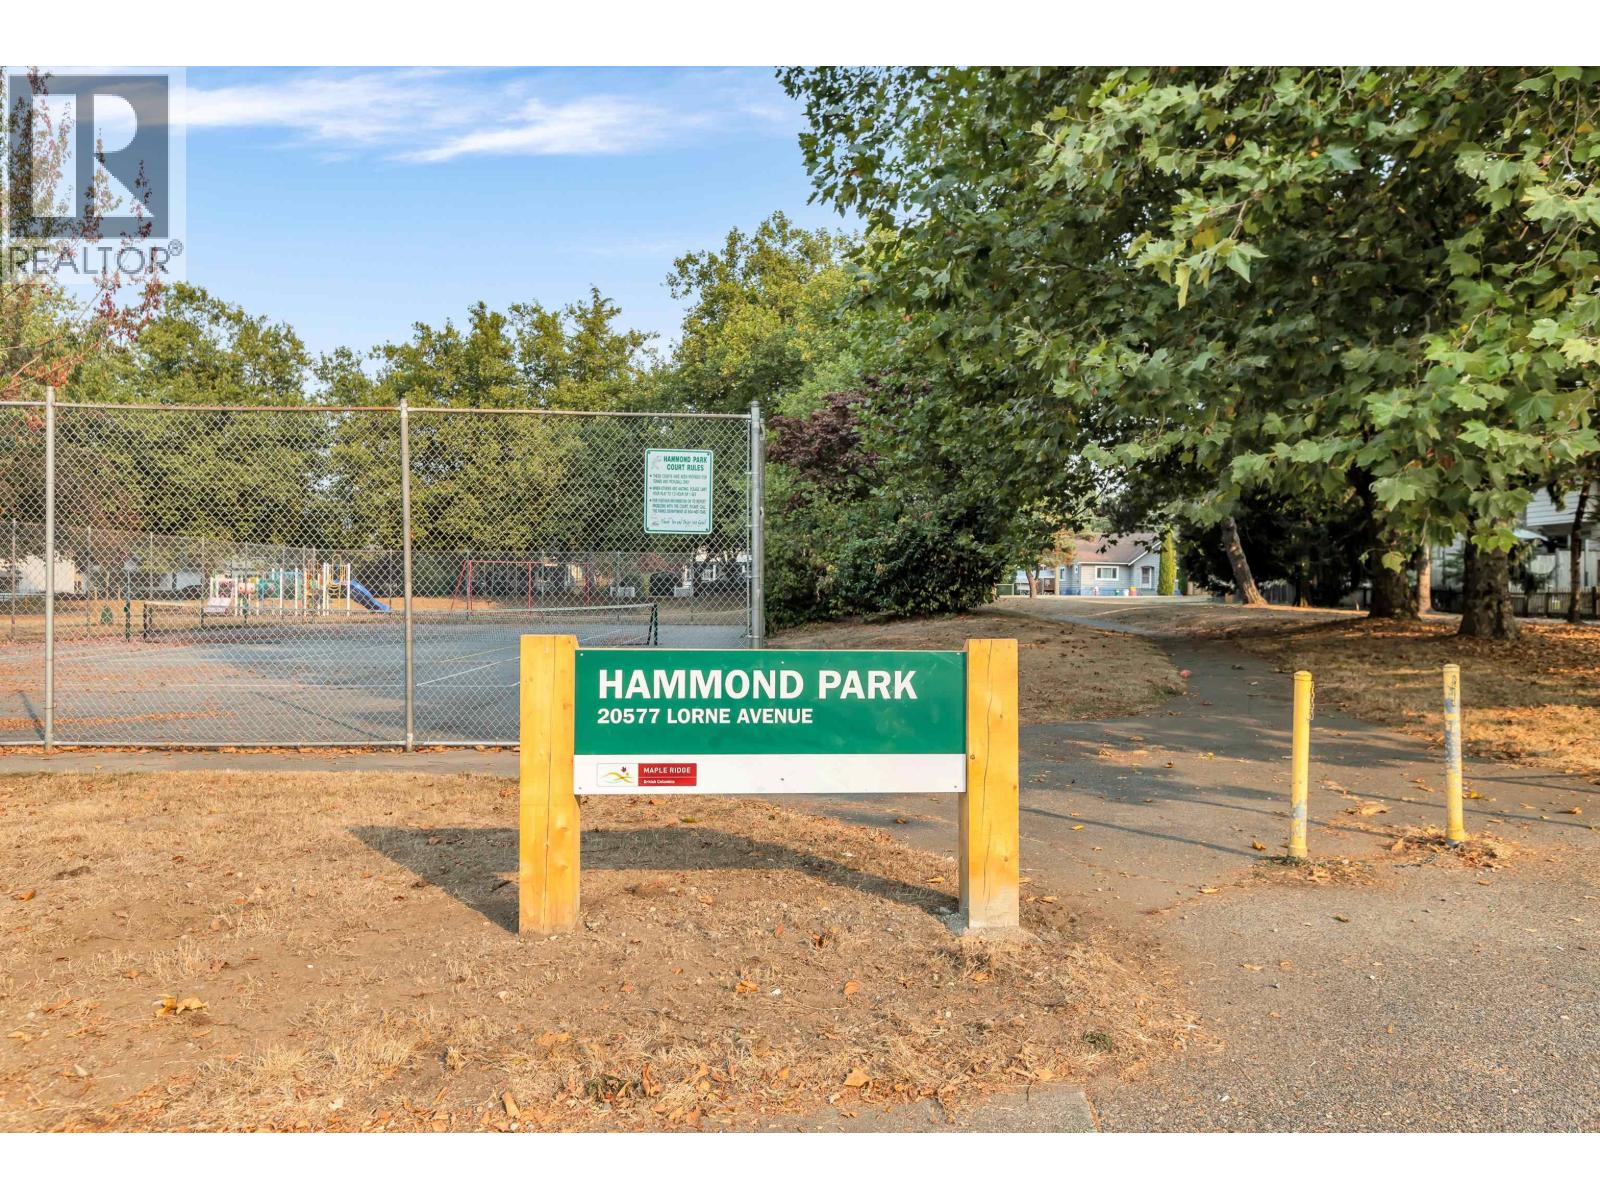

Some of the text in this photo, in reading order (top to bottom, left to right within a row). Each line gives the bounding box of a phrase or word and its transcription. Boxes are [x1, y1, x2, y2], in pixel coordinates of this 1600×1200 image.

[598, 669, 918, 700] HAMMOND PARK
[597, 708, 813, 724] 20577 LORNE AVENUE
